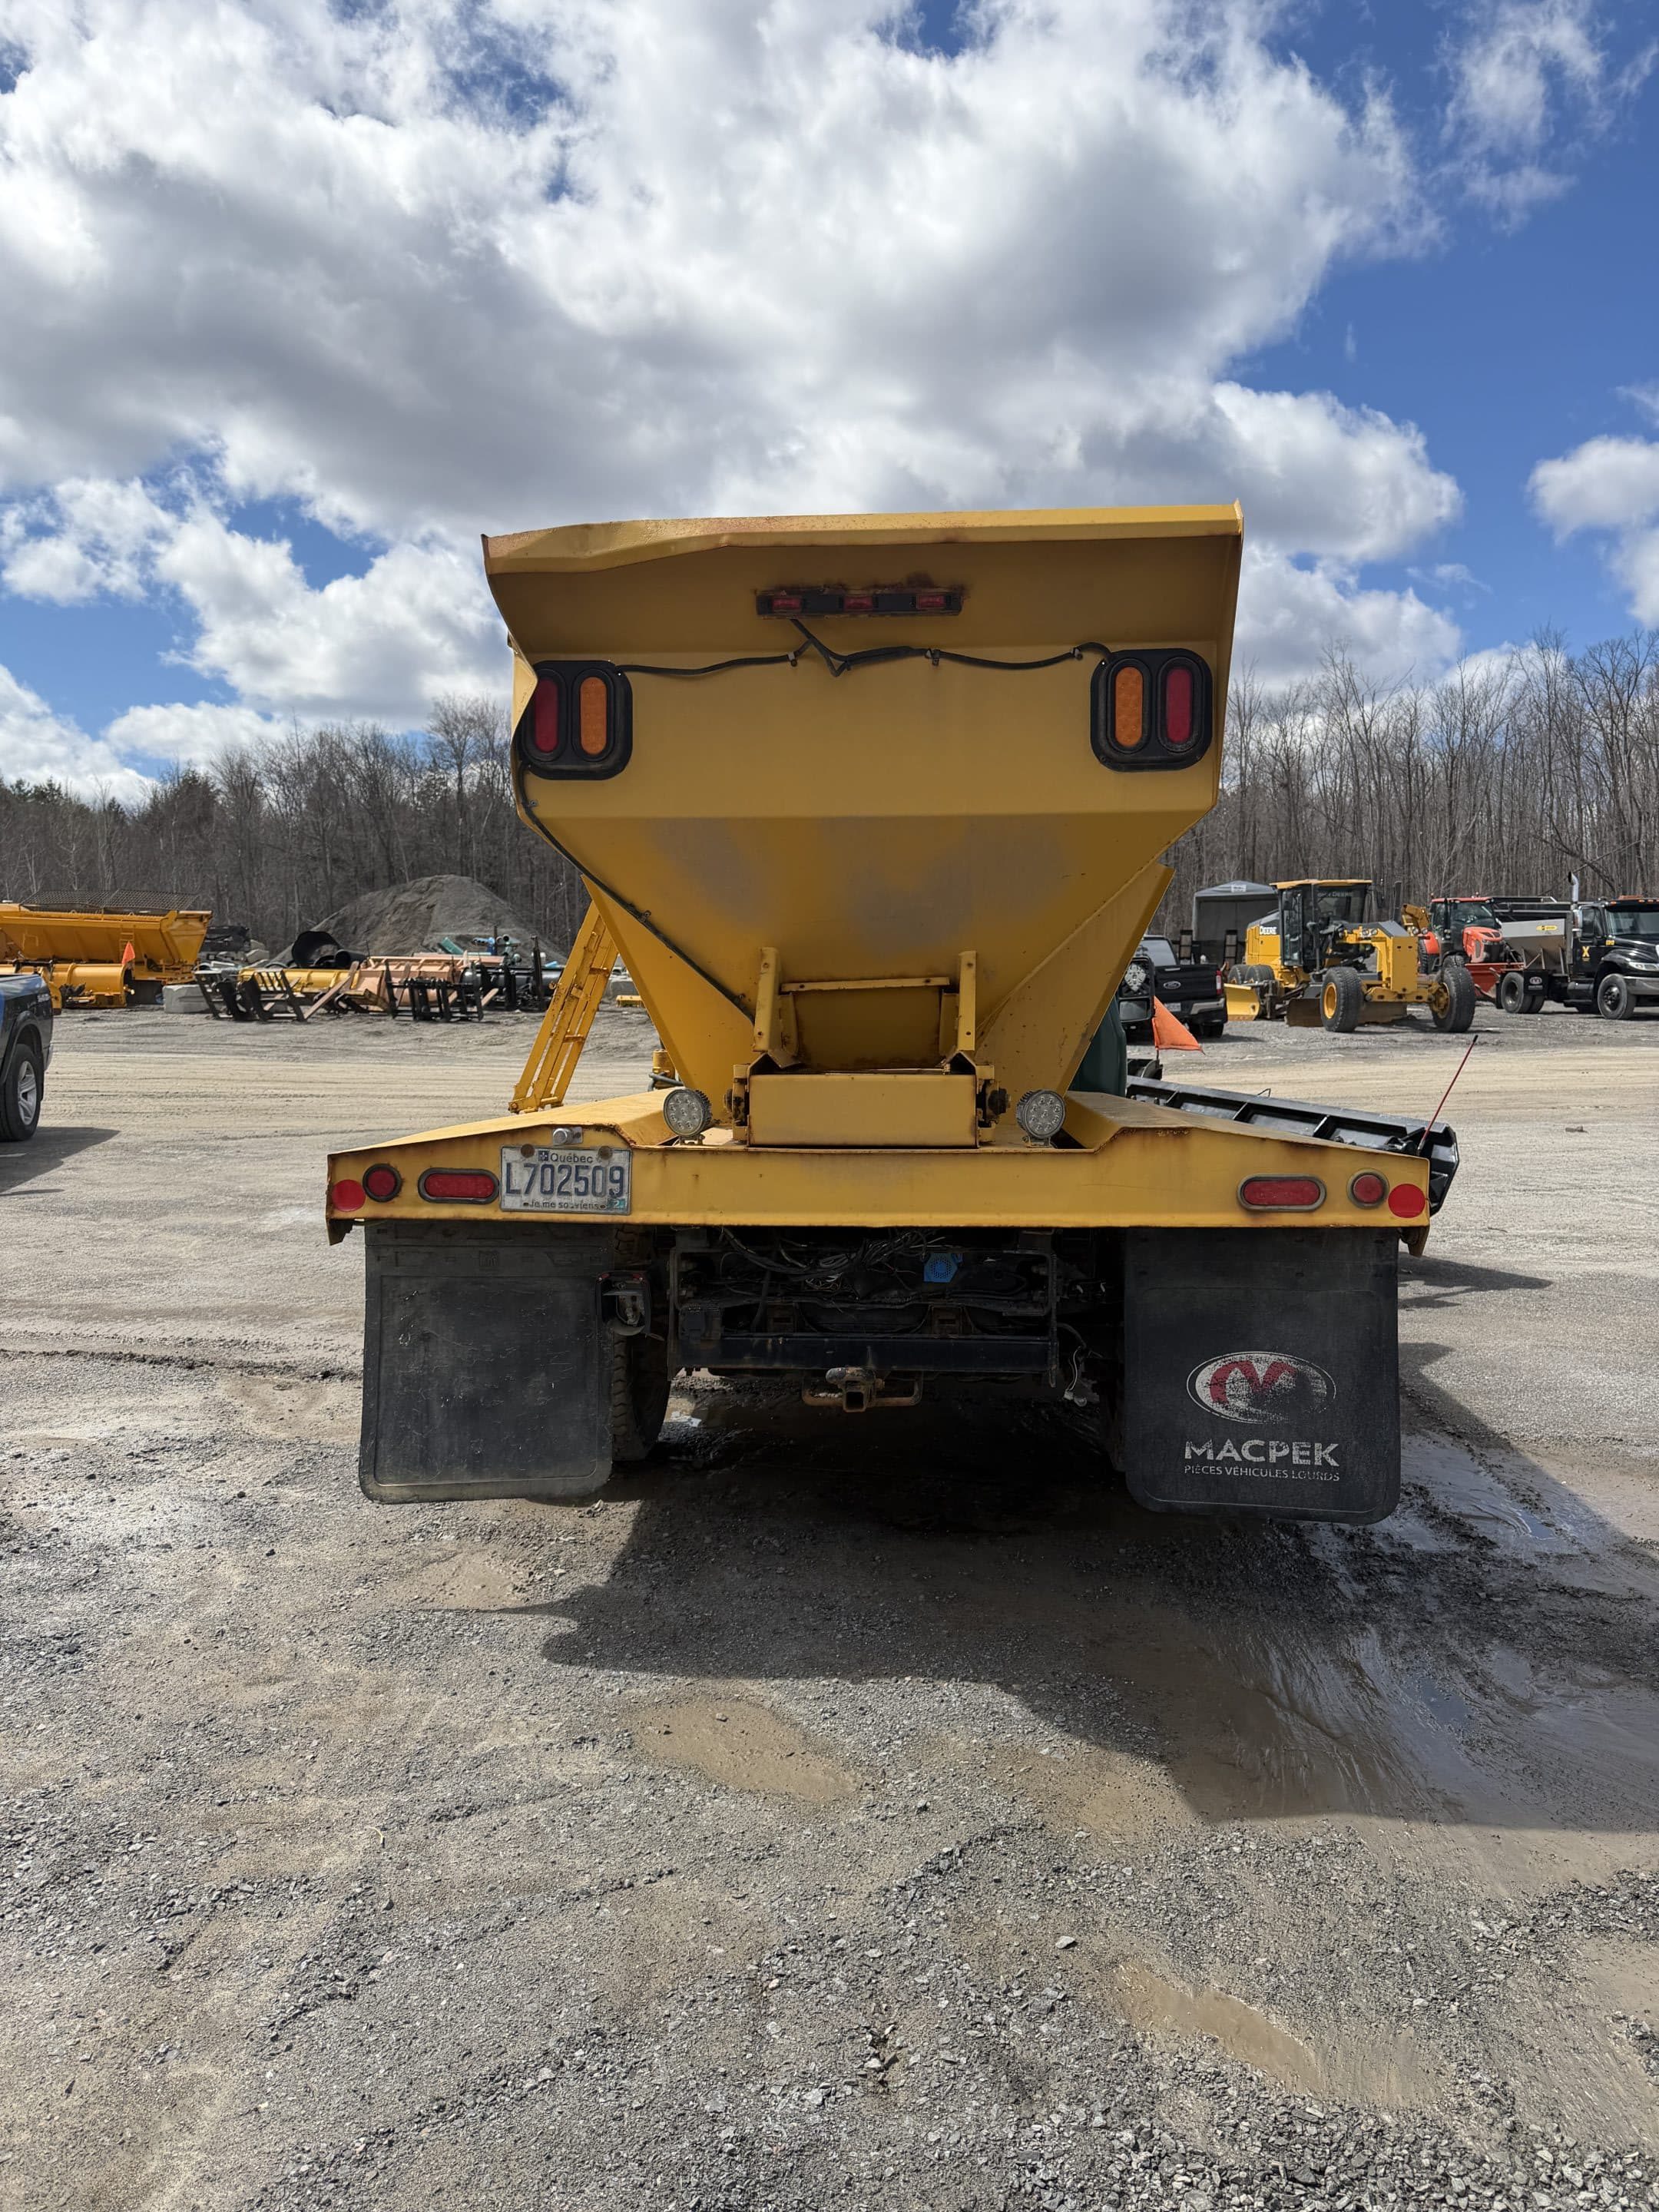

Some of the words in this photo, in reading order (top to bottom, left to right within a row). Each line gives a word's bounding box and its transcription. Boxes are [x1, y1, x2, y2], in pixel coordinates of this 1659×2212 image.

[550, 1152, 594, 1164] Québec
[505, 1162, 624, 1198] L702509
[558, 1200, 599, 1210] soviens
[1184, 1438, 1340, 1467] MACPEK
[1184, 1464, 1223, 1475] PIÈCES
[1225, 1465, 1289, 1479] VÉHICULES
